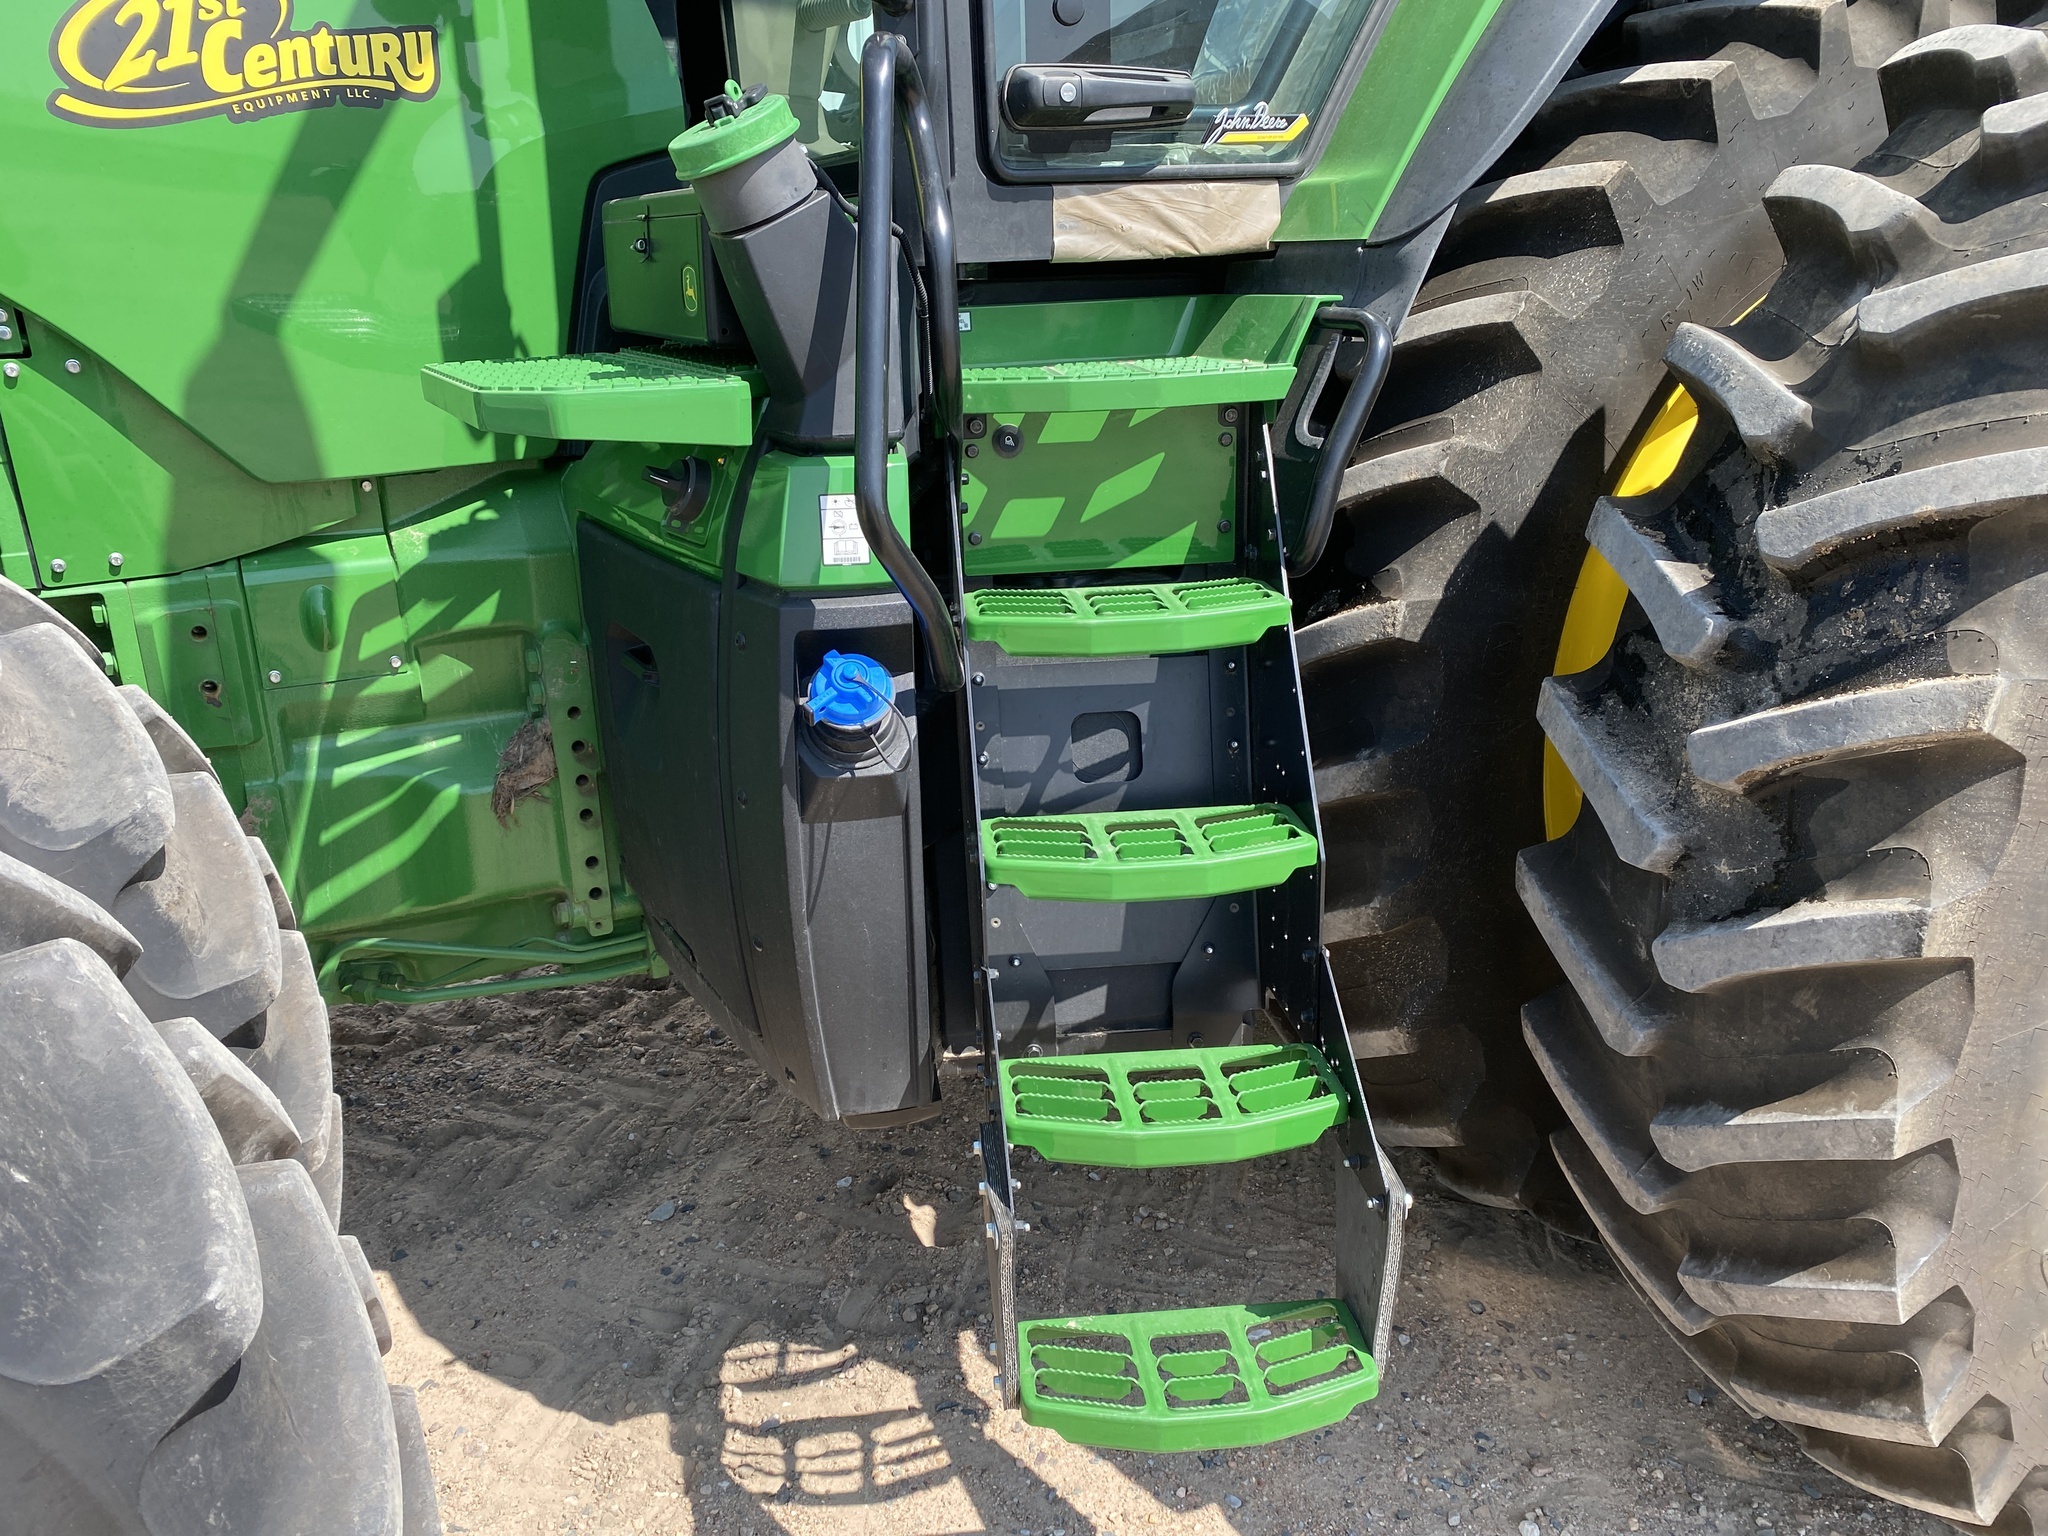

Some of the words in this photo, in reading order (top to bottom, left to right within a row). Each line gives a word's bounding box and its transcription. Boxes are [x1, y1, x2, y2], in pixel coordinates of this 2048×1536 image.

[231, 88, 332, 115] EQUIPMENT
[1201, 106, 1253, 150] John
[1248, 100, 1289, 131] Deere
